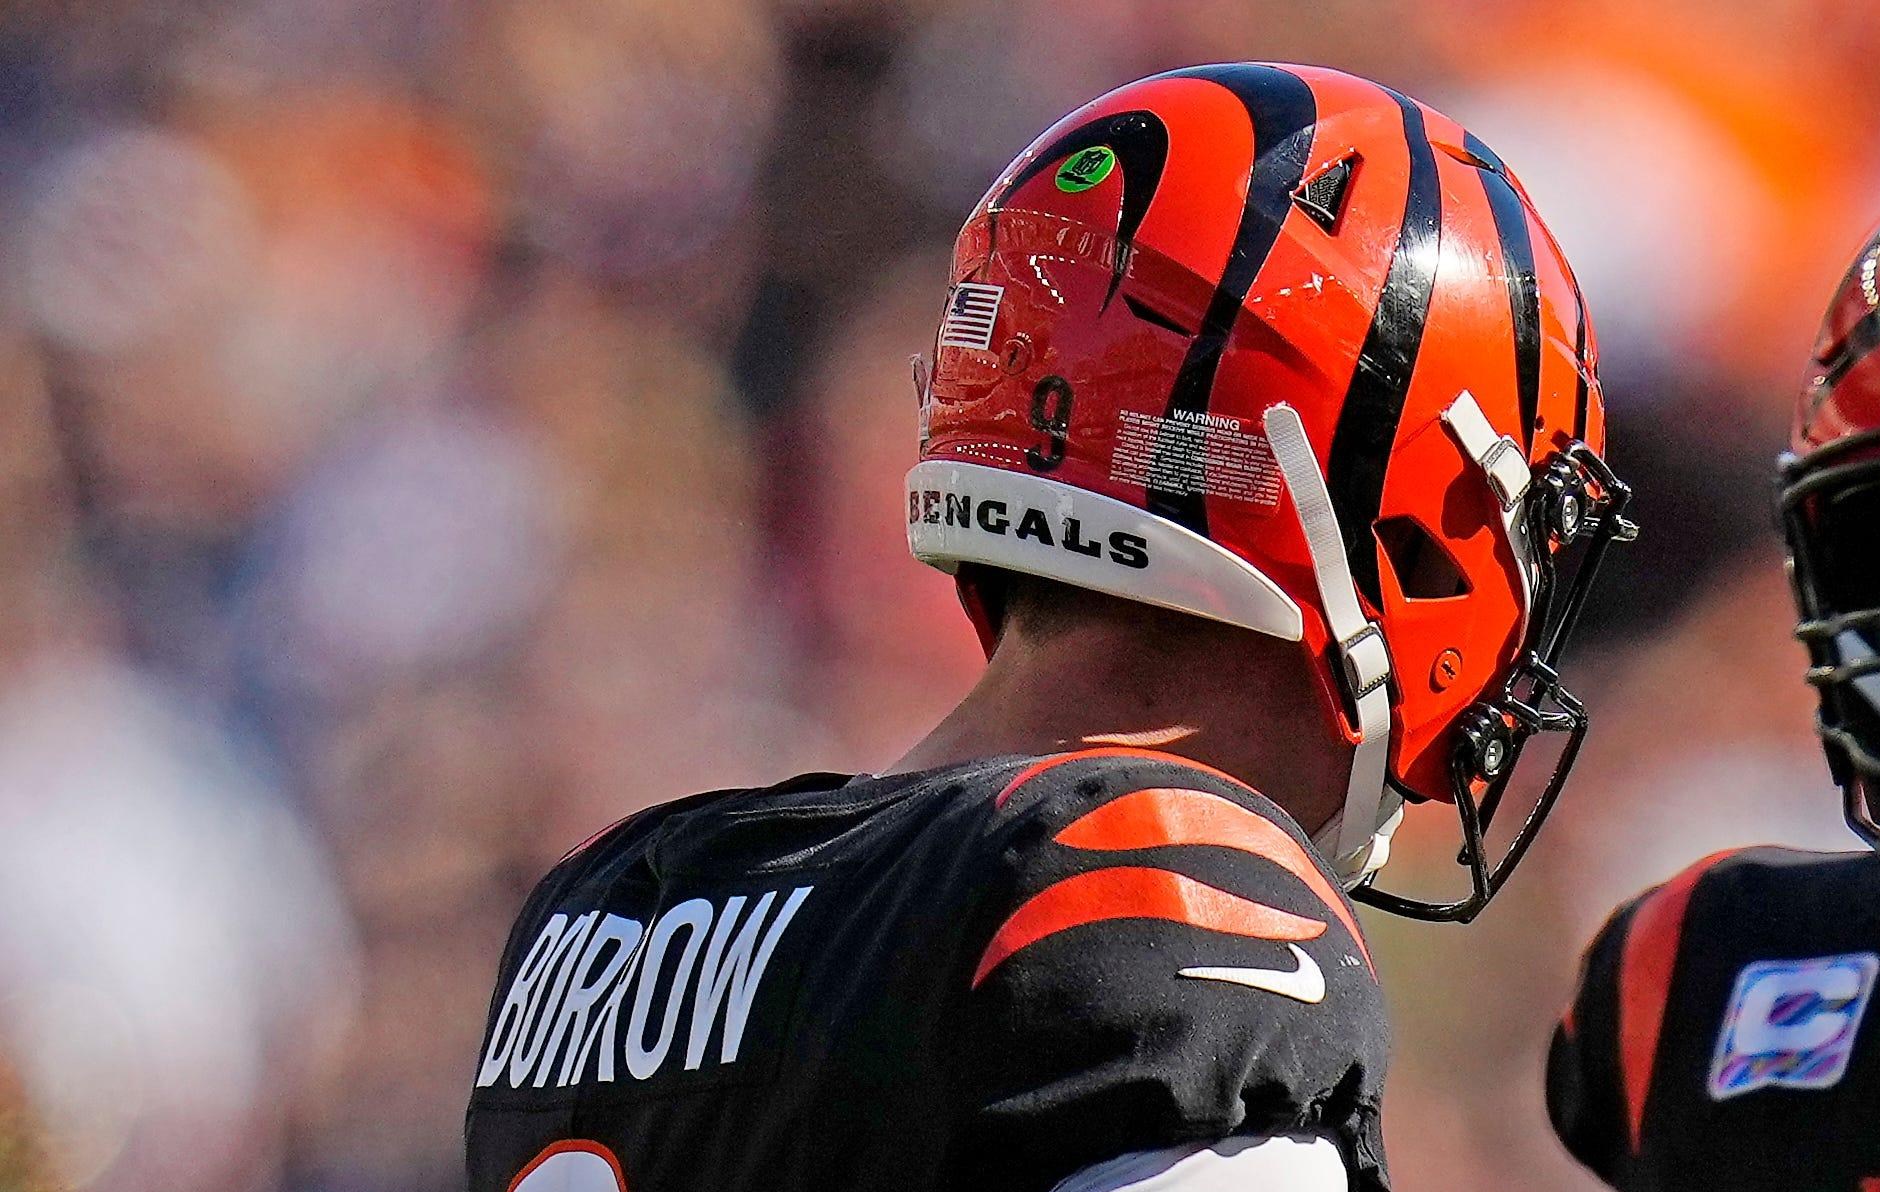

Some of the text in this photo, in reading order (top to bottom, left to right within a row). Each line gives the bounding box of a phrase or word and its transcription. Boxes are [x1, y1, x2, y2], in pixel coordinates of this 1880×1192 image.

[1026, 374, 1074, 472] 9
[1173, 408, 1240, 431] WARNING
[909, 490, 1149, 569] BENGALS
[1735, 967, 1861, 1055] C
